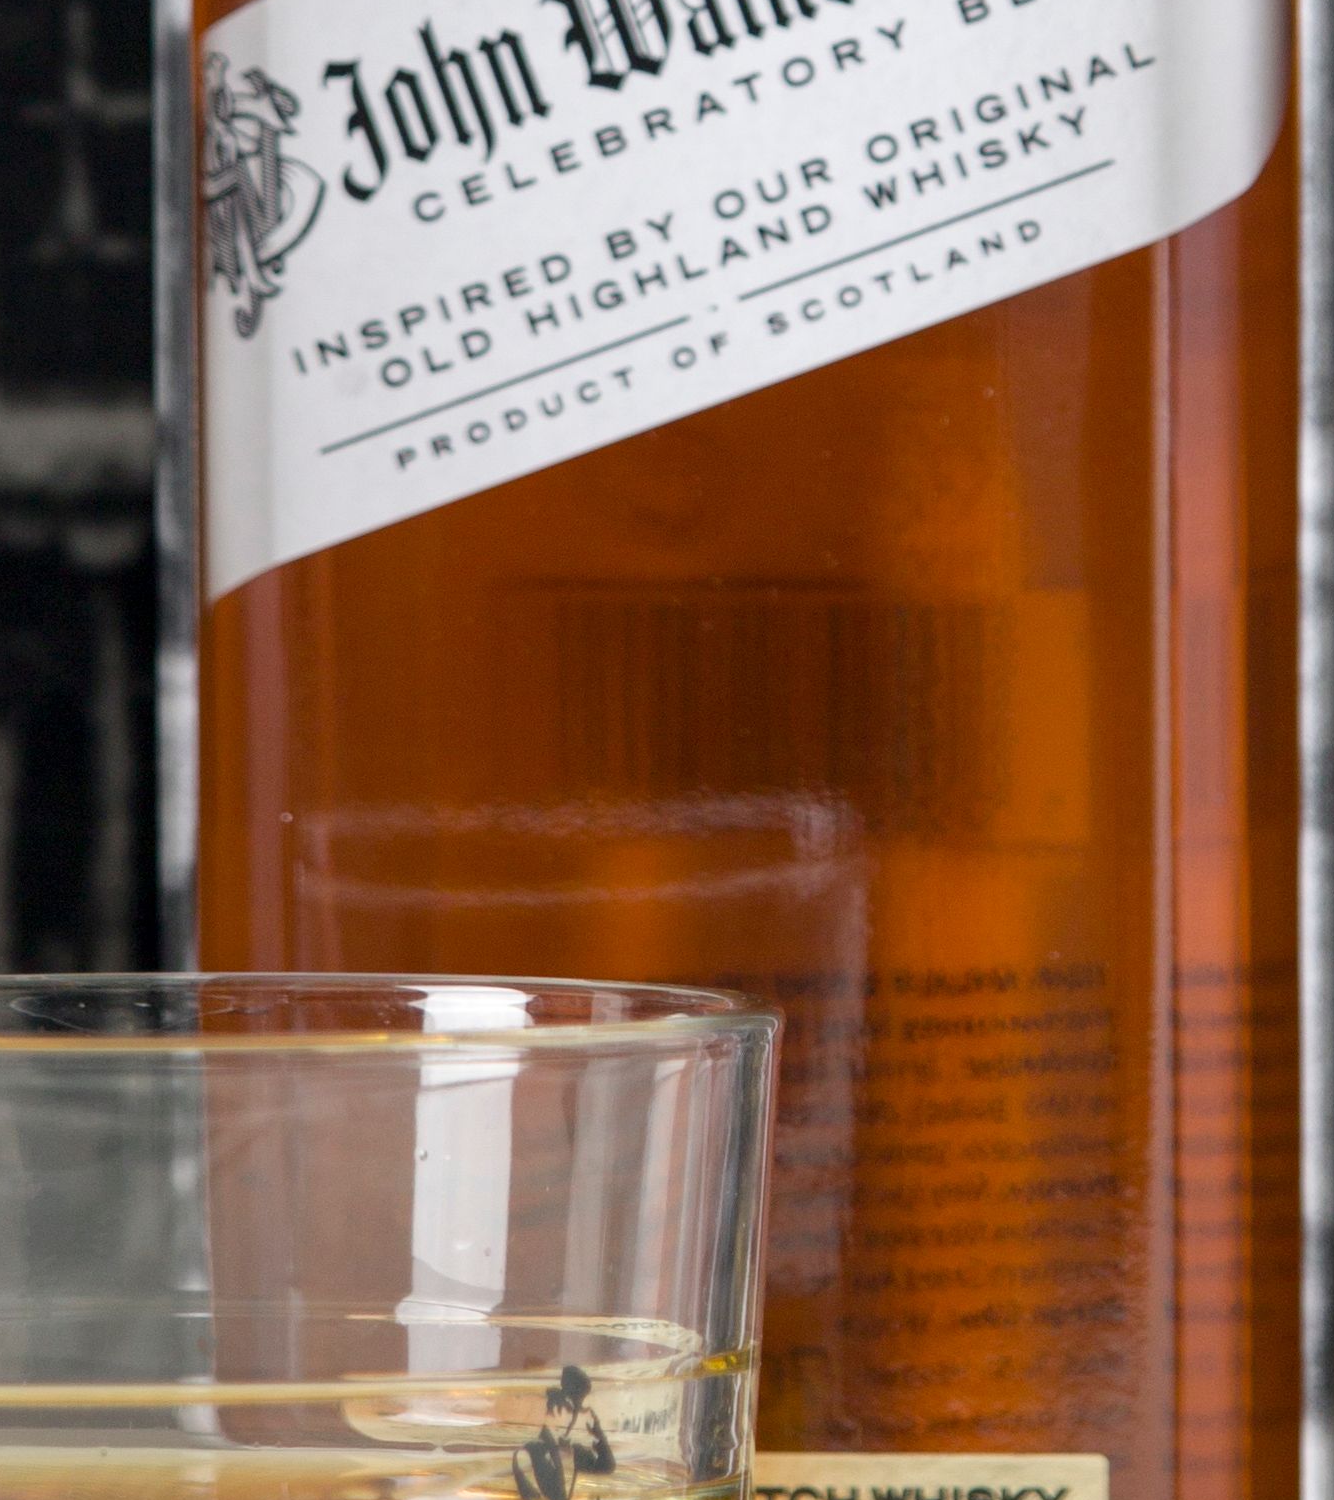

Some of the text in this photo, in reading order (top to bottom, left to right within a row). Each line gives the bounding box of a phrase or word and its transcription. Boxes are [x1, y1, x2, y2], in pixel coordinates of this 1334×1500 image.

[293, 43, 1156, 375] INSPIRED BY OUR ORIGINAL
[321, 18, 554, 204] John
[413, 21, 905, 224] CELEBRATORY
[380, 108, 1087, 389] OLD HIGHLAND WHISKY
[394, 217, 1044, 472] PRODUCT OF SCOTLAND
